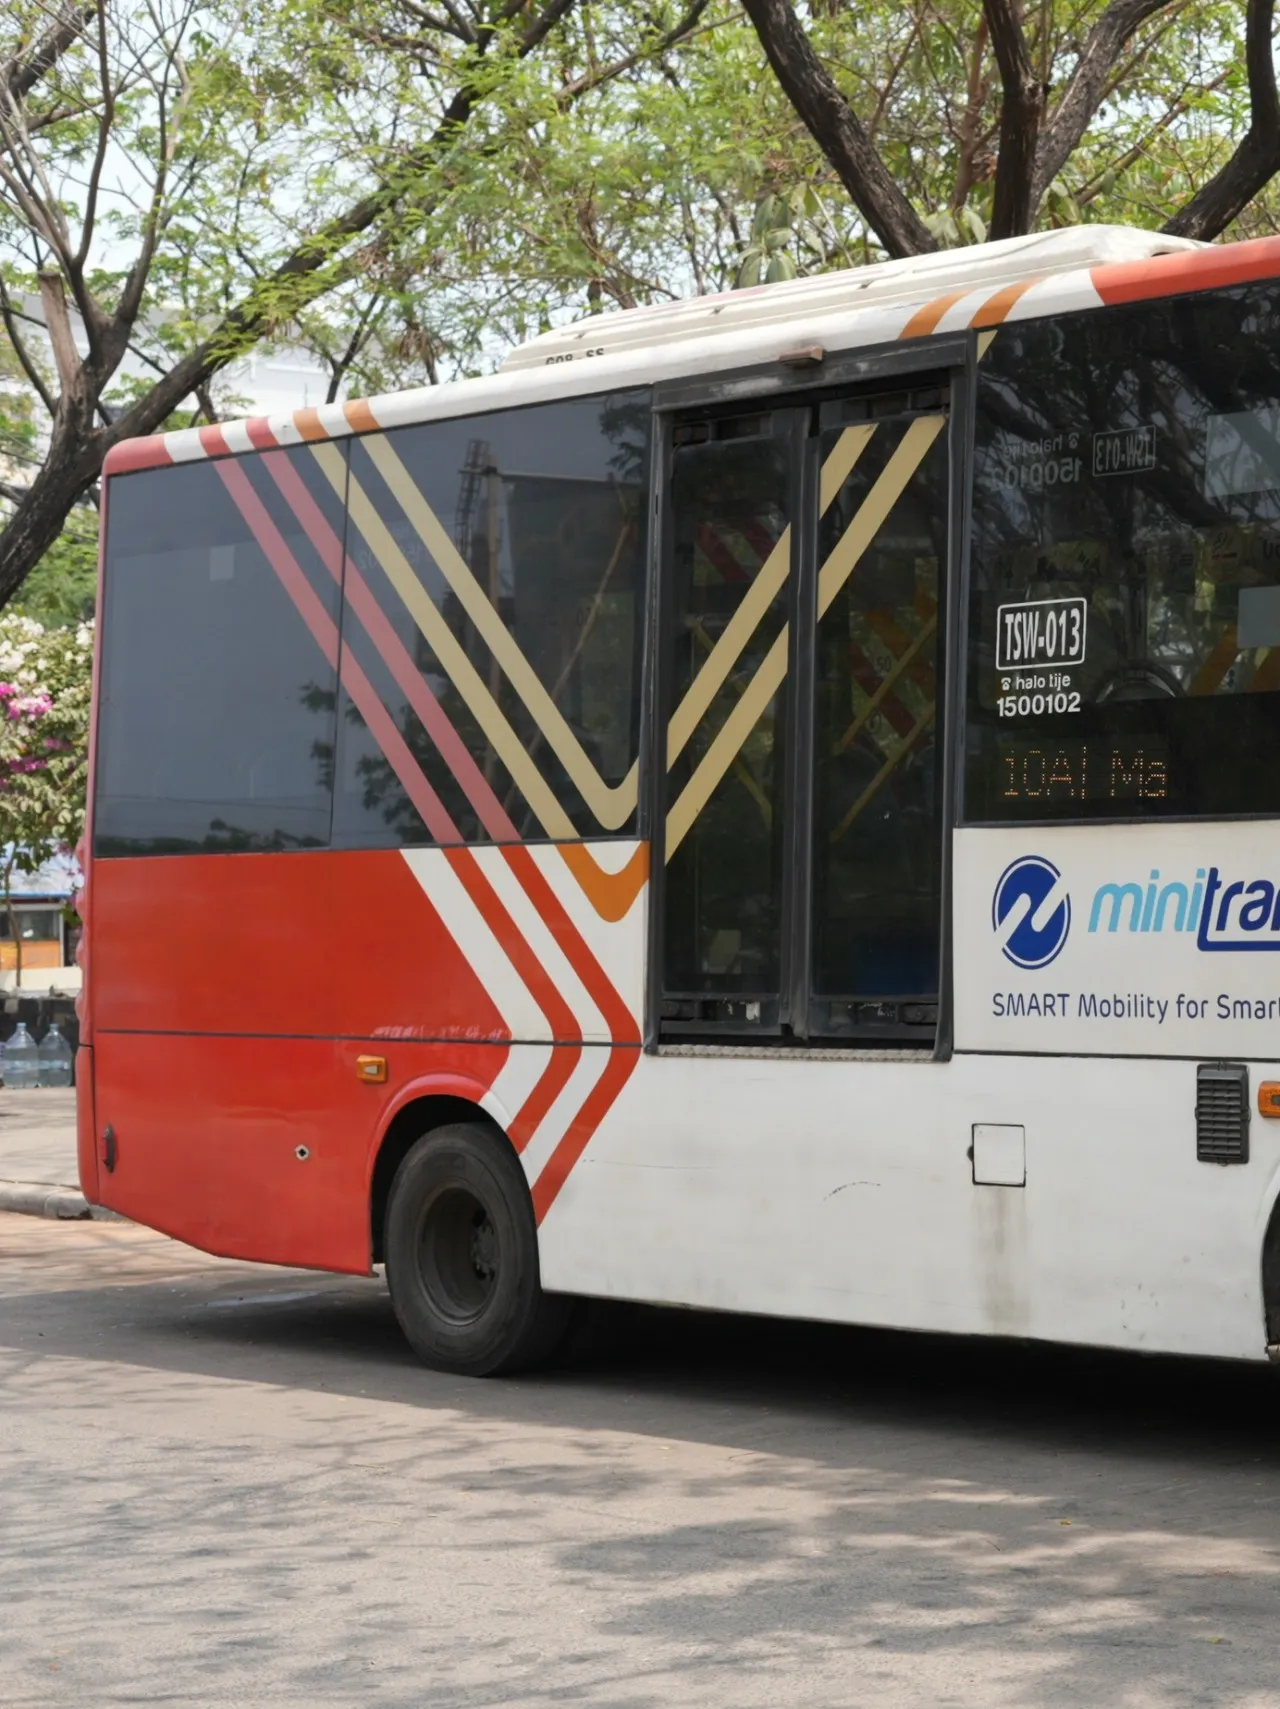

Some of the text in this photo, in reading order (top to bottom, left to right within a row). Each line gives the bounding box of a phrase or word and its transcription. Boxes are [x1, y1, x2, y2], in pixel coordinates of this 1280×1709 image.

[1005, 608, 1081, 661] TSW-013
[1016, 673, 1071, 692] halo tije
[996, 692, 1081, 717] 1500102
[1110, 750, 1167, 797] Ma
[992, 993, 1070, 1018] SMART
[1078, 993, 1168, 1025] Mobility
[1176, 993, 1208, 1019] for
